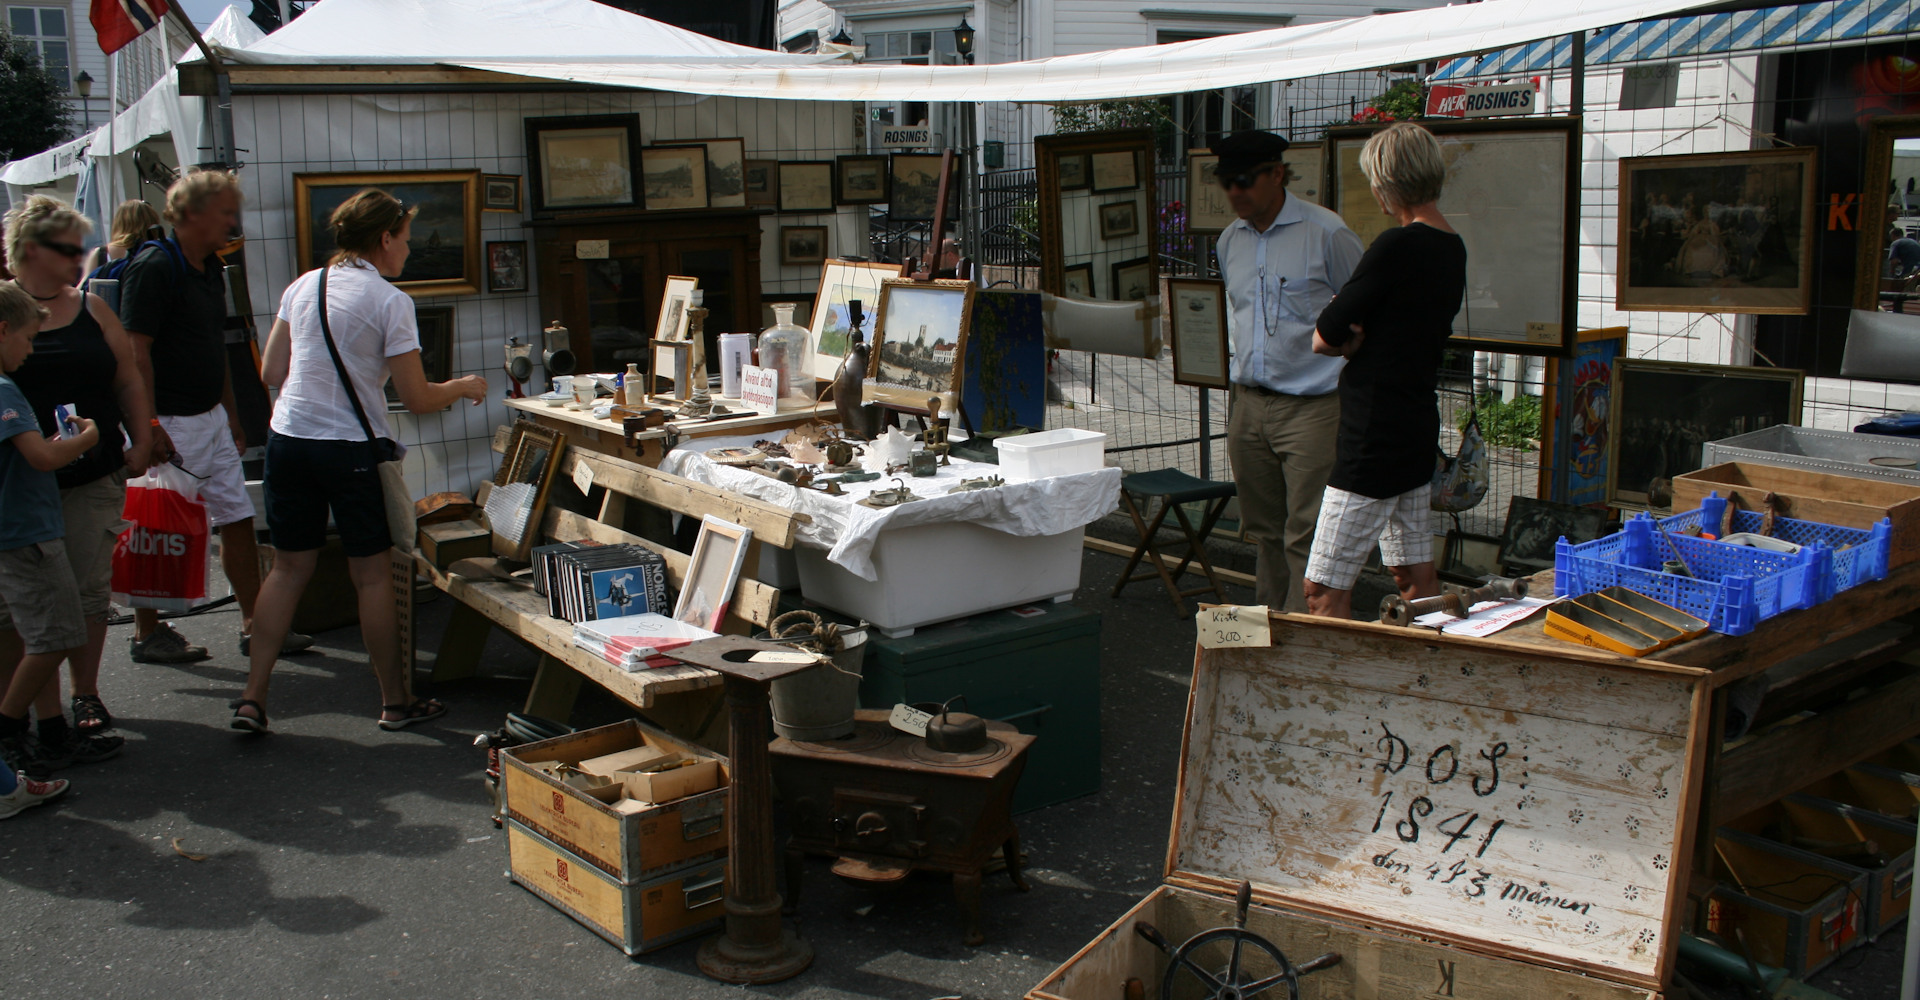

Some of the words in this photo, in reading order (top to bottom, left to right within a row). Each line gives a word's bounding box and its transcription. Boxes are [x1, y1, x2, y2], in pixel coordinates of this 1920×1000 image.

[1466, 89, 1531, 111] ROSING'S
[884, 130, 928, 143] ROSING'S
[652, 563, 669, 616] NORGES
[1213, 611, 1239, 622] Kiste
